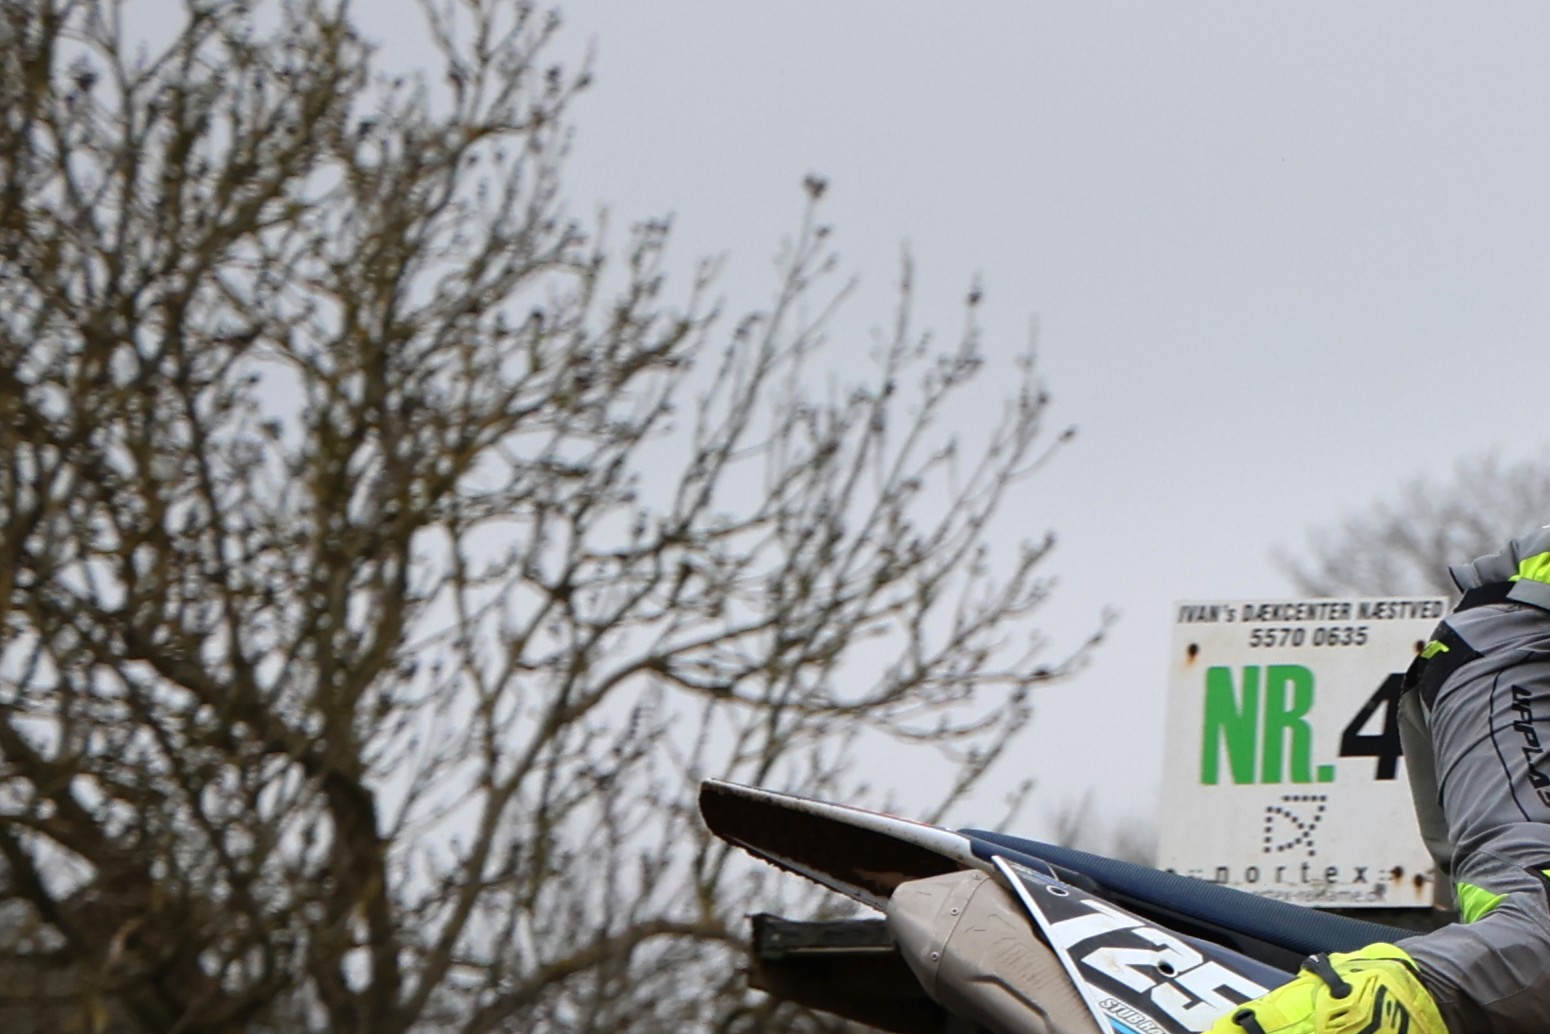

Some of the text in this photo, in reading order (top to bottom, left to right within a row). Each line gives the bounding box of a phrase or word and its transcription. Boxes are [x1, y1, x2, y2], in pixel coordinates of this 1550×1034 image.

[1356, 599, 1444, 620] NÆSTVED
[1249, 626, 1369, 648] 5570 0635
[1200, 664, 1406, 785] NR. 4
[1050, 899, 1272, 1033] 725
[1098, 997, 1143, 1032] STUB
